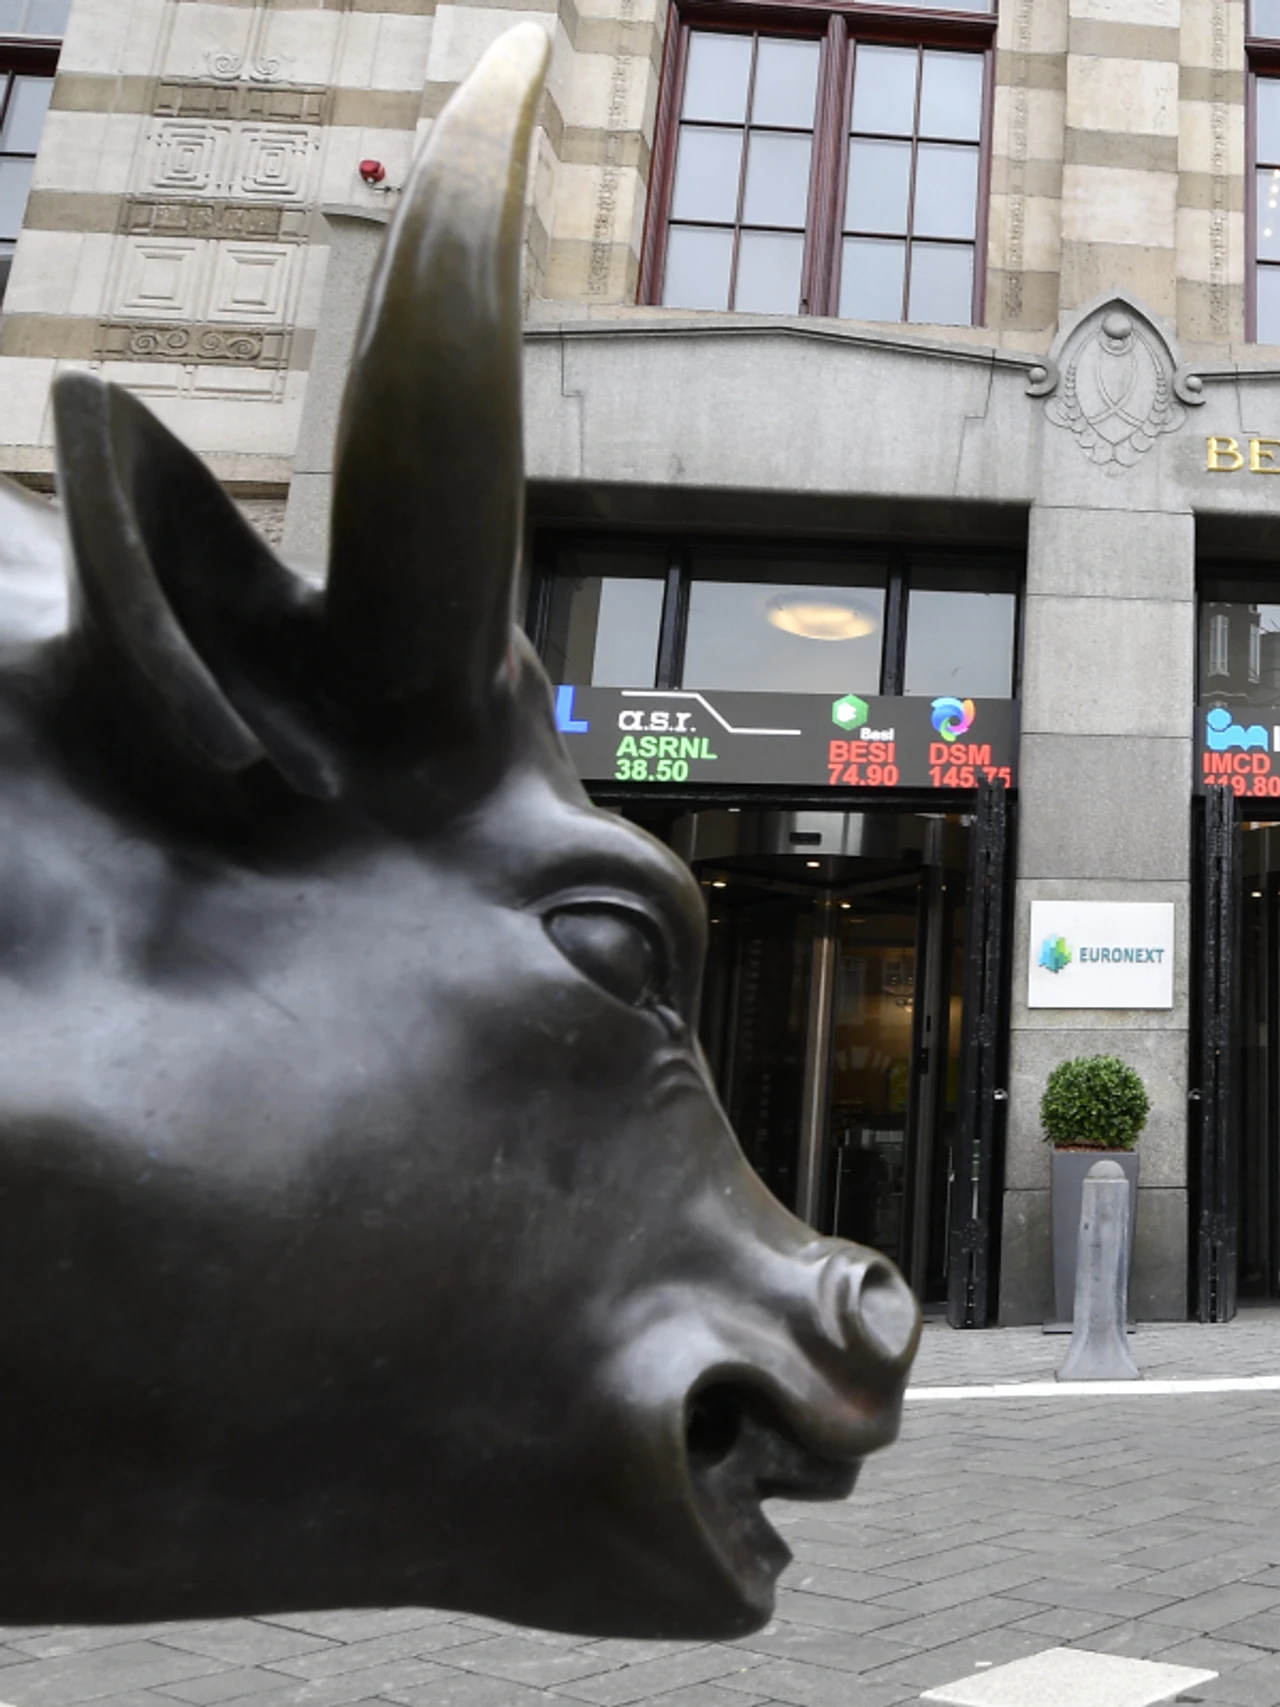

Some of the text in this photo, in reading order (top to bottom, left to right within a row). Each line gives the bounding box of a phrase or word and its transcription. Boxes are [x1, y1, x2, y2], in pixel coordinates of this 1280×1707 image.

[618, 710, 697, 732] a.s.r.
[616, 735, 718, 759] ASRNL
[829, 740, 896, 763] BESI
[929, 743, 992, 765] DSM
[614, 759, 689, 782] 38.50
[1203, 752, 1271, 774] IMCD
[828, 764, 899, 786] 74.90
[1079, 947, 1164, 963] EURONEXT
